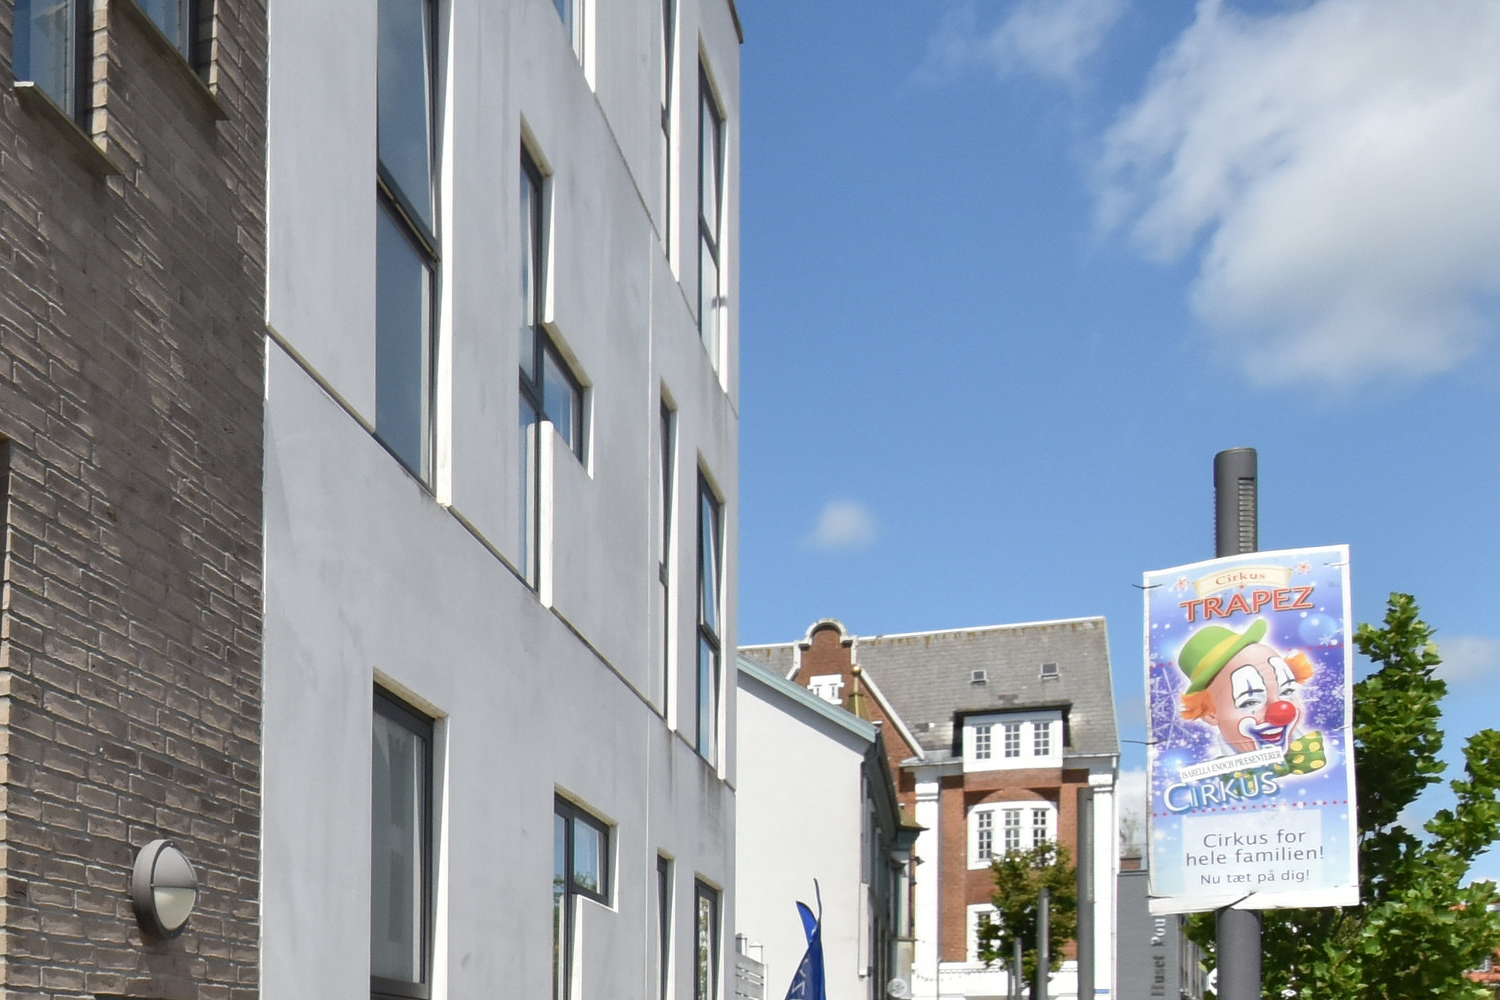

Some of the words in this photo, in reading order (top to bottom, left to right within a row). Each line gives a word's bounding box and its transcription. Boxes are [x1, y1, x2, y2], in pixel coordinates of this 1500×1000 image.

[1215, 572, 1267, 586] Cirkus
[1181, 586, 1314, 622] TRAPEZ
[1181, 766, 1211, 779] ISABELLA
[1211, 760, 1234, 774] ENOCH
[1164, 772, 1278, 812] CIRKUS
[1203, 832, 1268, 848] Cirkus
[1276, 828, 1306, 844] for
[1186, 851, 1227, 866] hele
[1236, 846, 1324, 864] familien!
[1200, 874, 1221, 884] Nu
[1227, 873, 1252, 883] tæt
[1258, 869, 1275, 884] på
[1281, 869, 1310, 883] dig!
